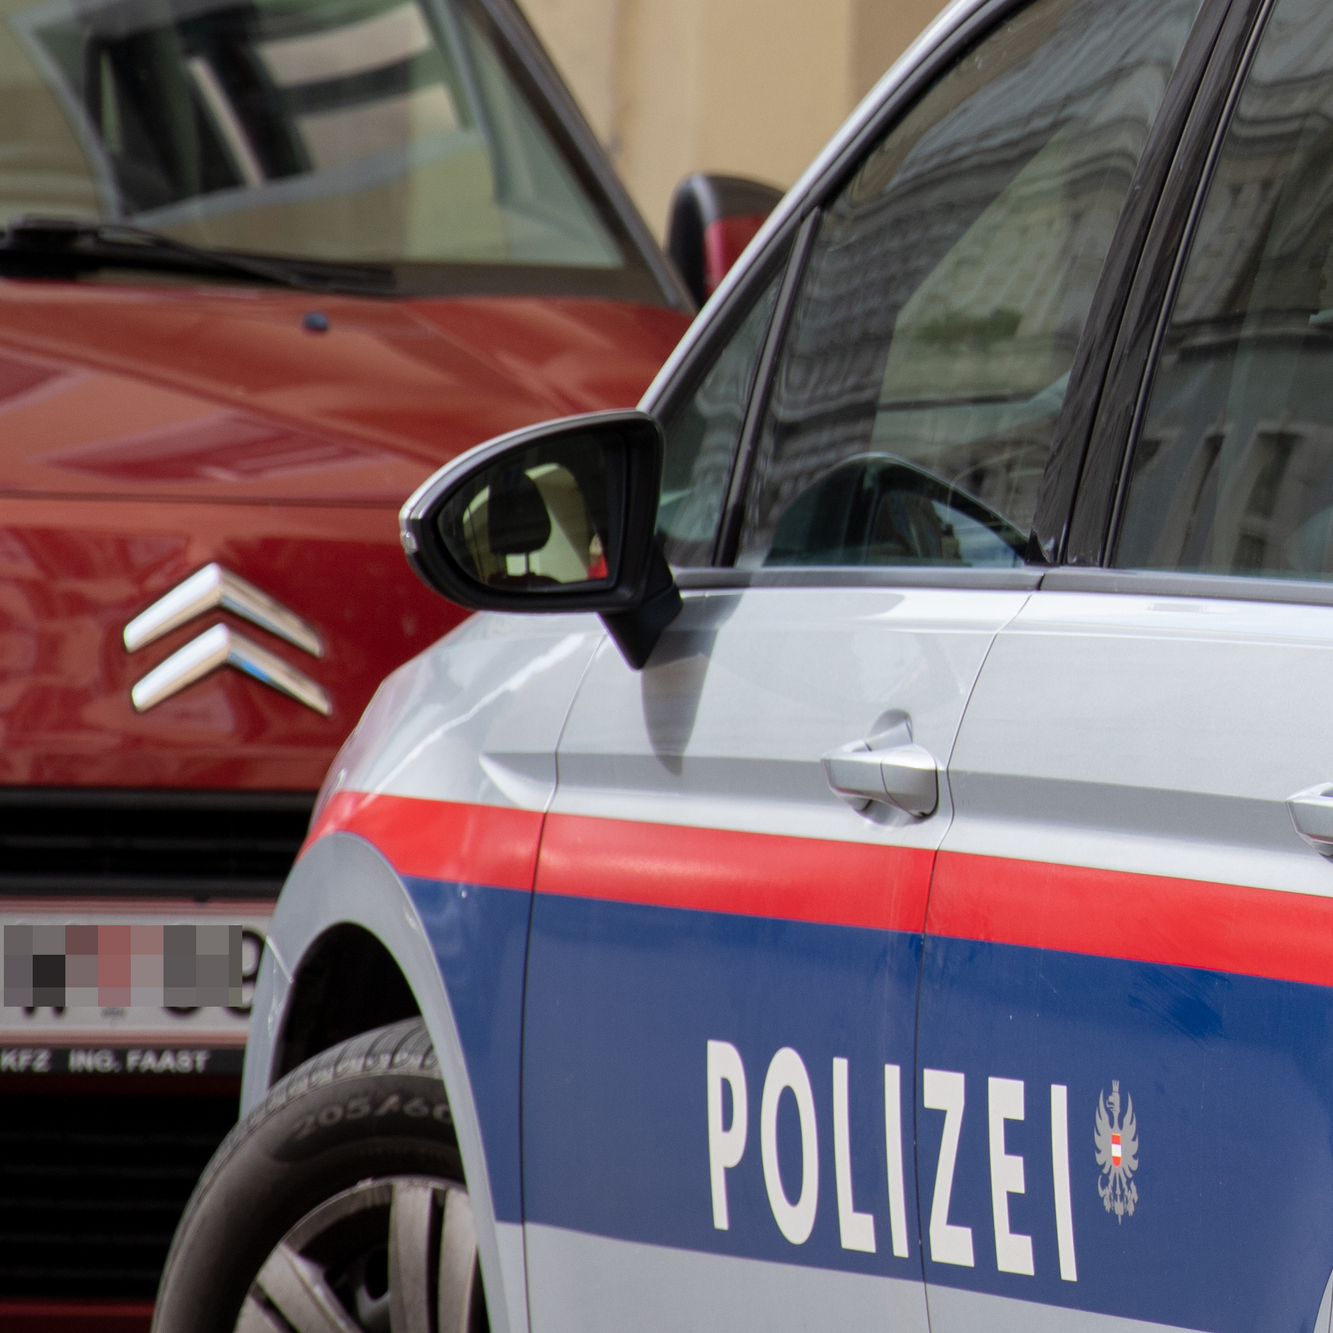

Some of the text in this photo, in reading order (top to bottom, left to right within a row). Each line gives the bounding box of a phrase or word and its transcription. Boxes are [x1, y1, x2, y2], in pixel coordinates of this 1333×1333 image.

[0, 1049, 51, 1073] KFZ
[126, 1049, 210, 1073] FAAST
[706, 1039, 1078, 1282] POLIZEI
